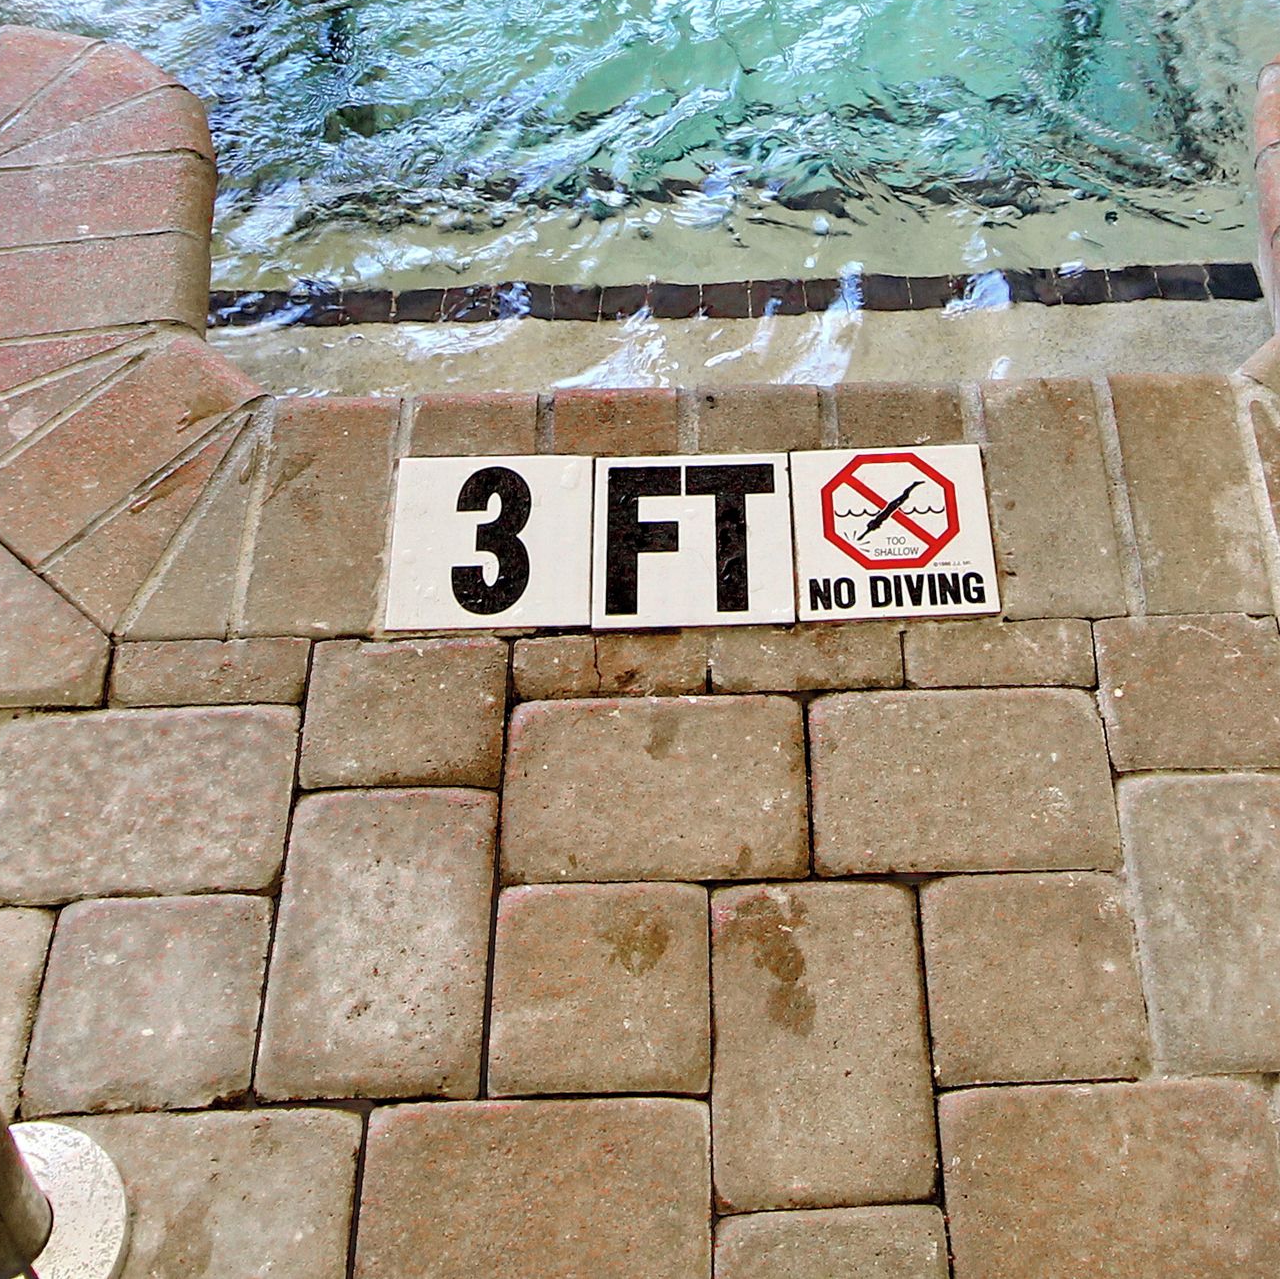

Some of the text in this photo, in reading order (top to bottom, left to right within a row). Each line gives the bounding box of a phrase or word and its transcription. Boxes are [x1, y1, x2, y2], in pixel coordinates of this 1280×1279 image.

[451, 463, 775, 616] 3 FT
[873, 546, 920, 558] SHALLOW
[886, 536, 907, 546] TOO
[808, 571, 987, 611] NO DIVING
